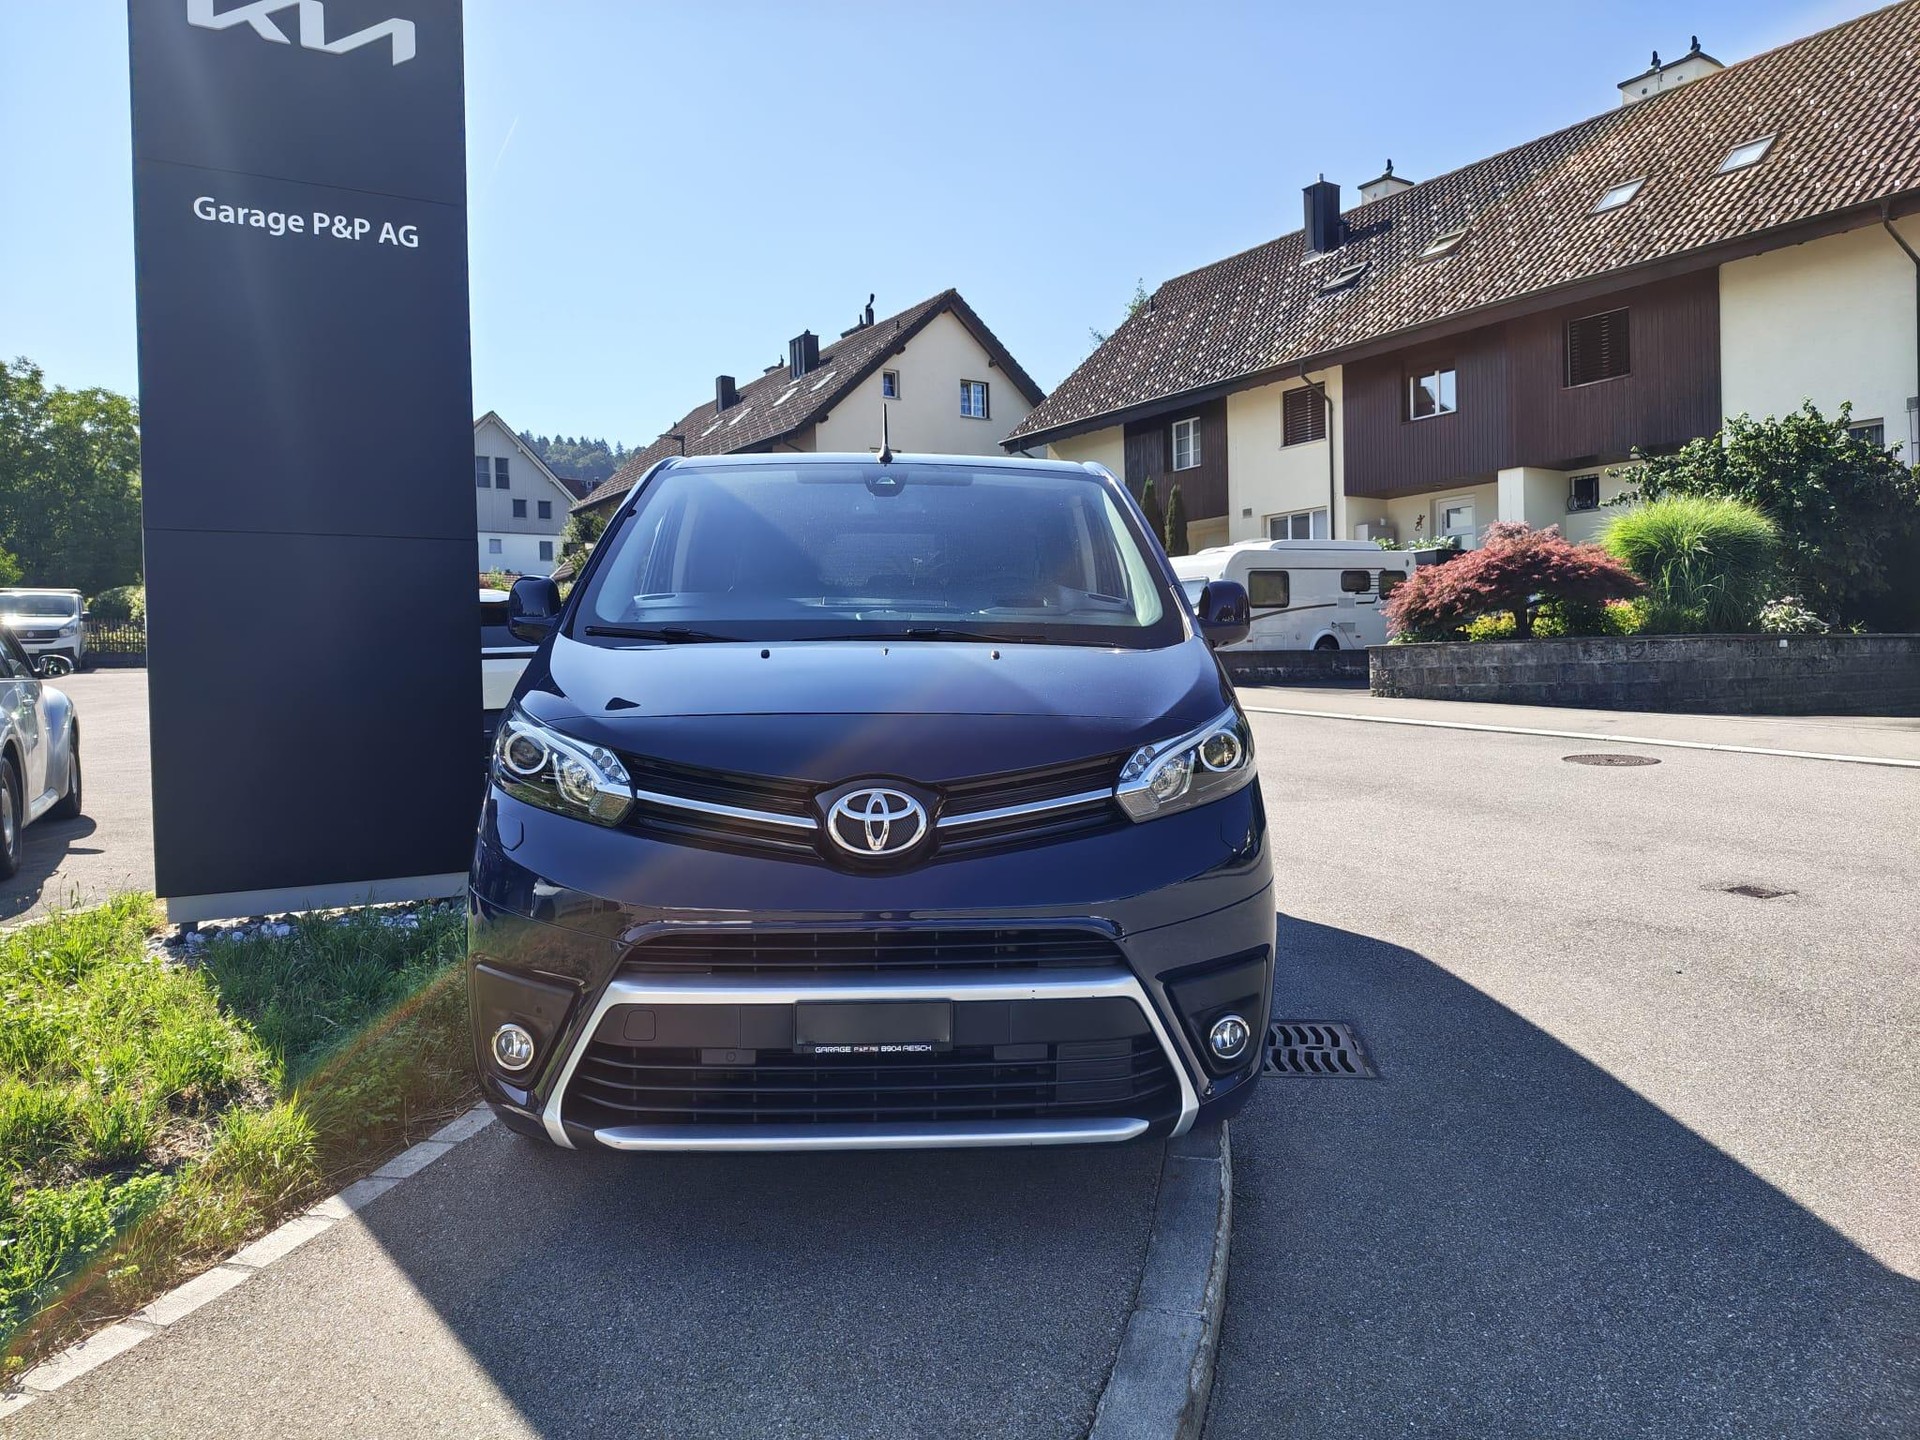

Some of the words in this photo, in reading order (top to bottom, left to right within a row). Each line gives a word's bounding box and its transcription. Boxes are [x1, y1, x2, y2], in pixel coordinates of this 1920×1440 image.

[193, 196, 305, 236] Garage
[312, 212, 370, 241] P&P
[377, 222, 419, 248] AG
[815, 1045, 852, 1054] GARAGE
